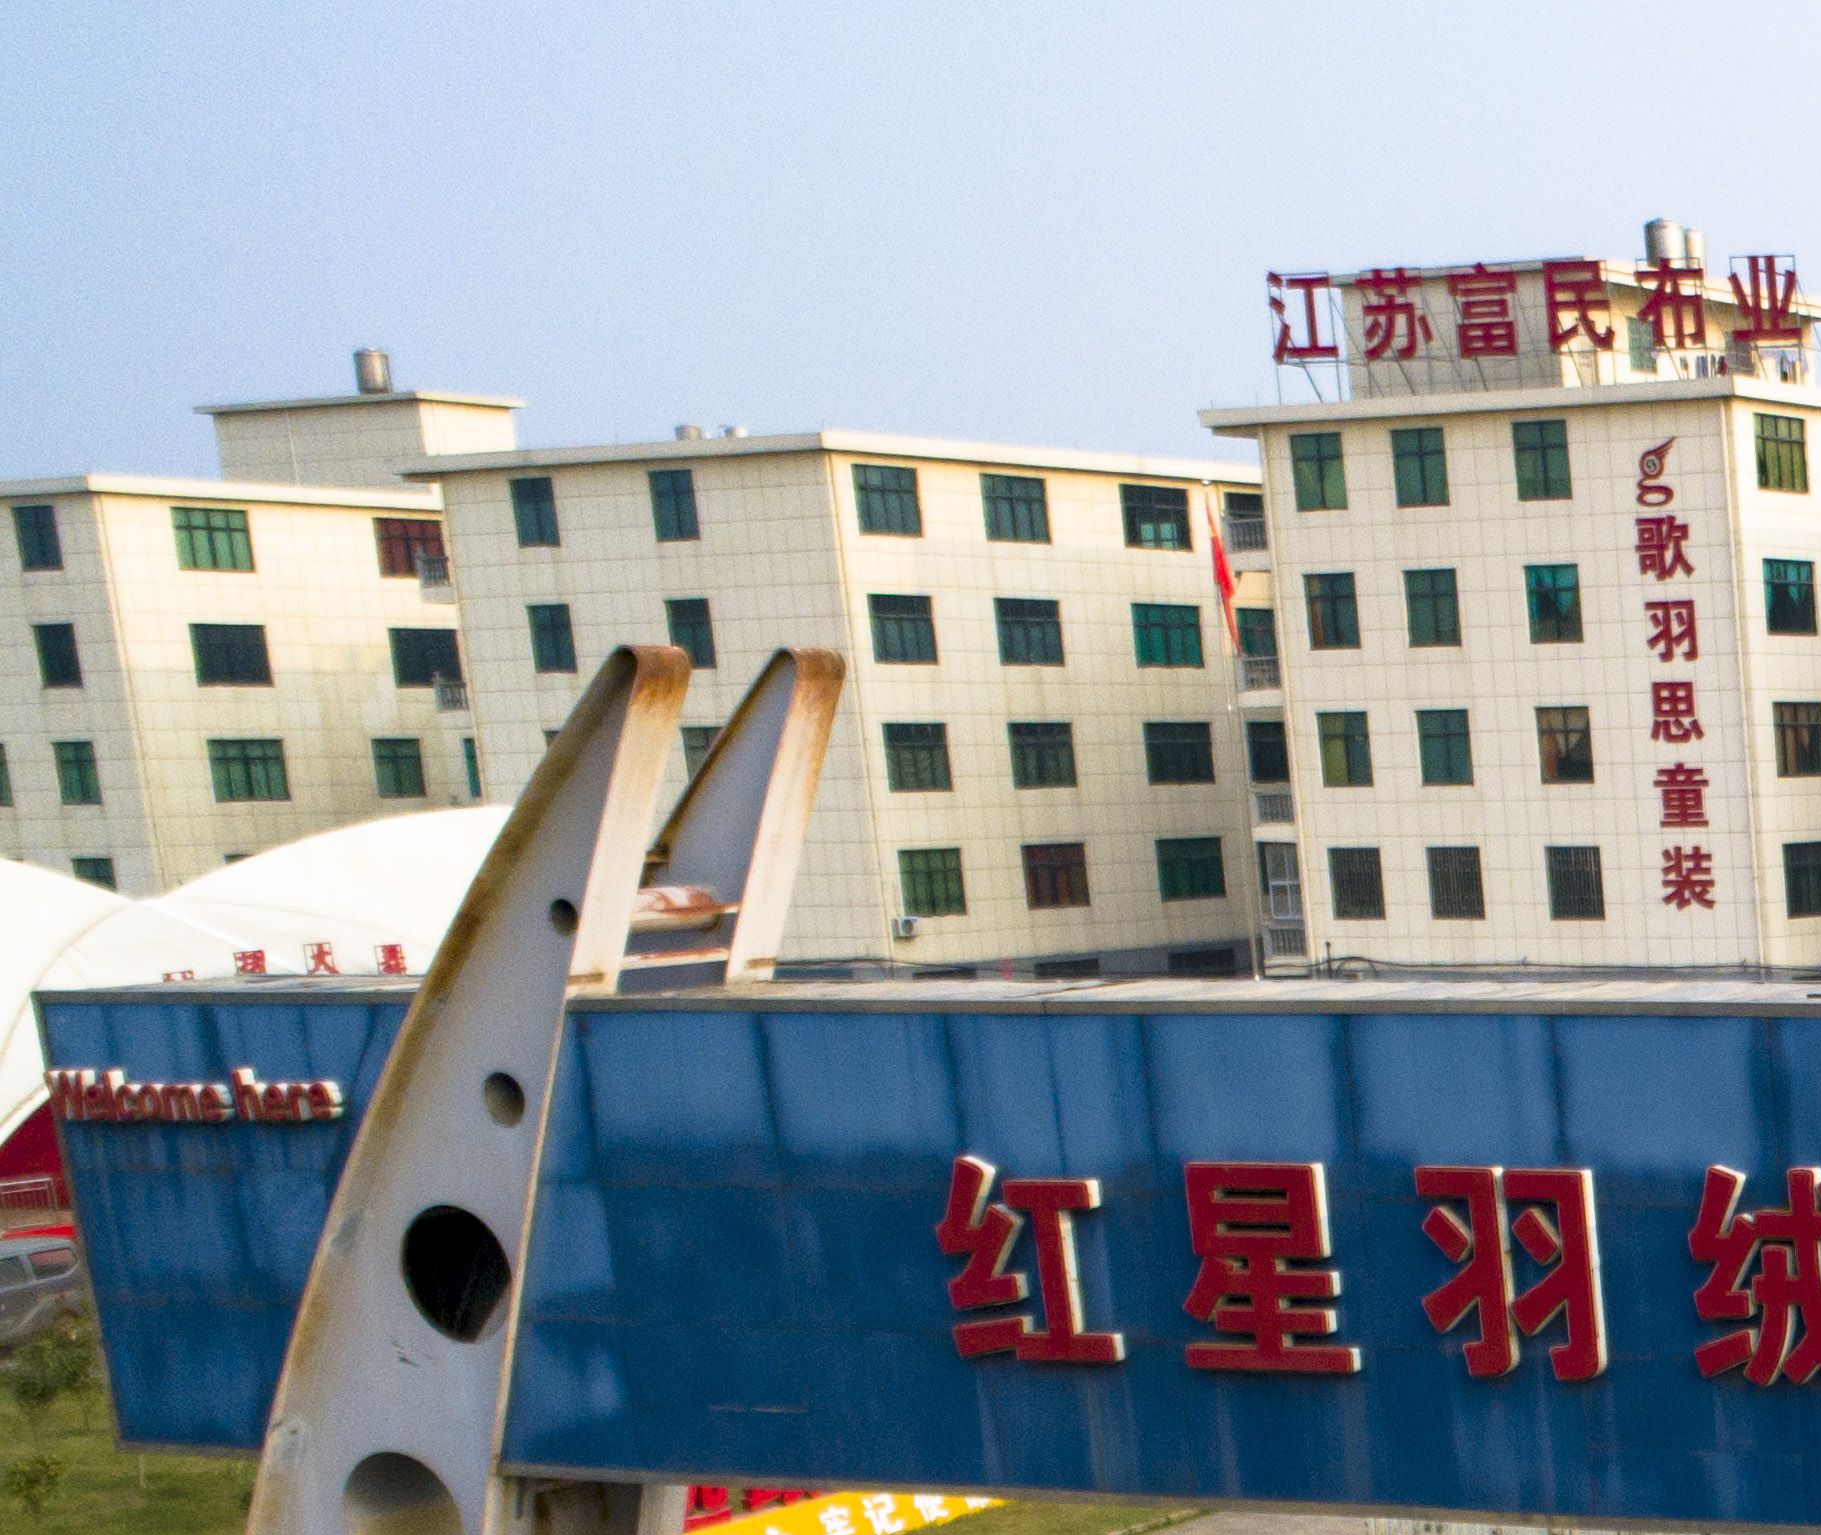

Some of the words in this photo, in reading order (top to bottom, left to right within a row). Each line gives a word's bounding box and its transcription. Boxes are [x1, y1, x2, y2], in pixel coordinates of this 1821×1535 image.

[1267, 255, 1802, 364] 江苏富民布业
[1635, 515, 1716, 910] 歌羽思童装
[45, 1068, 236, 1121] Welcome
[231, 1066, 345, 1121] here
